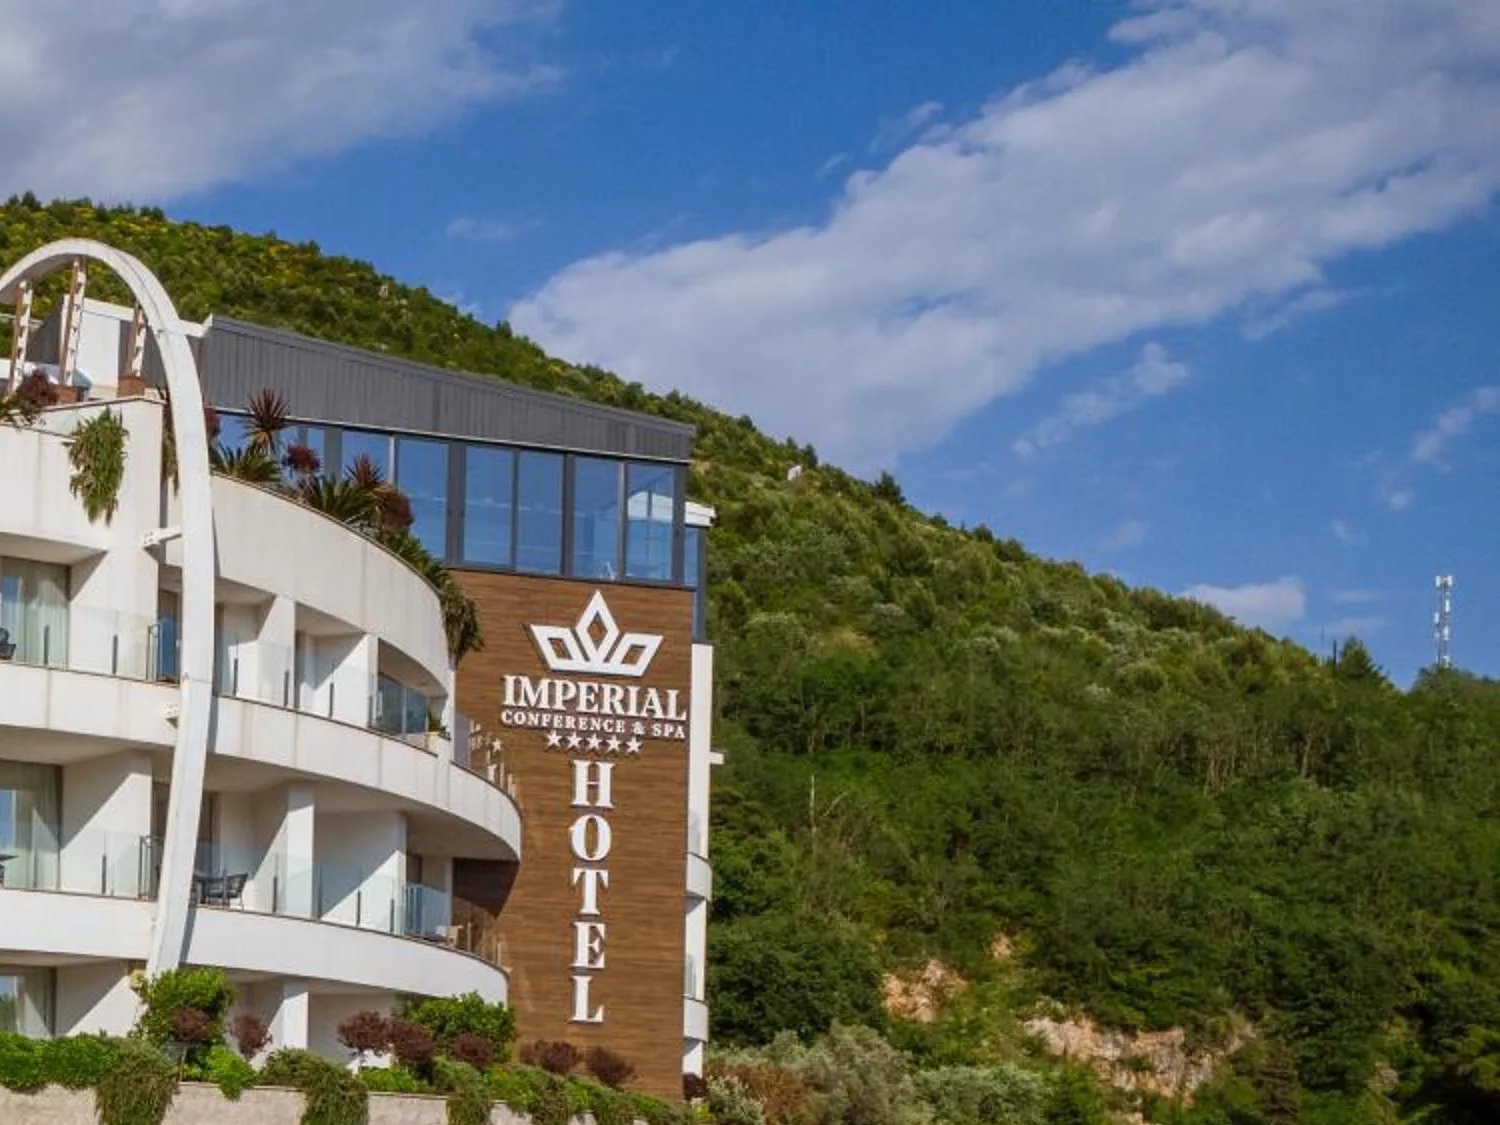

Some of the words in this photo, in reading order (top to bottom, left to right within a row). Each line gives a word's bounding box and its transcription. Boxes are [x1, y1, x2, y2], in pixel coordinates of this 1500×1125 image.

[503, 675, 687, 721] IMPERIAL
[501, 710, 626, 733] CONFERENCE
[632, 721, 645, 735] &
[652, 722, 686, 739] SPA
[570, 759, 613, 1023] HOTEL
